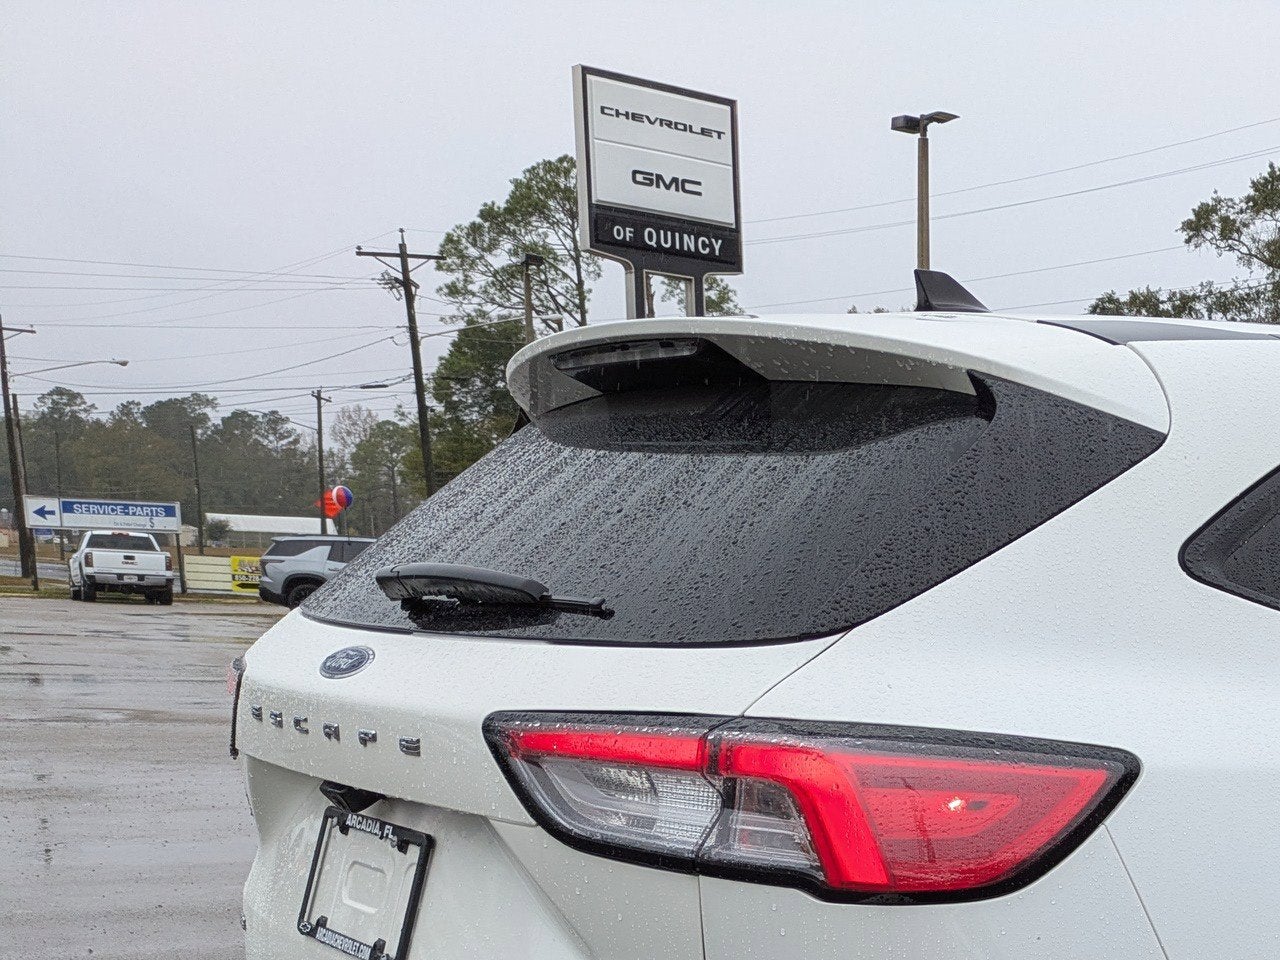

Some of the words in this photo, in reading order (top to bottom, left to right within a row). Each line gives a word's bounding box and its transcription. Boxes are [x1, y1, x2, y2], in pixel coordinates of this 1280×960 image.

[600, 105, 726, 140] CHEVROLET
[631, 169, 703, 197] GMC
[613, 225, 635, 242] OF
[643, 227, 723, 257] QUINCY
[73, 504, 166, 518] SERVICE-PARTS
[345, 813, 382, 840] ARCADIA,
